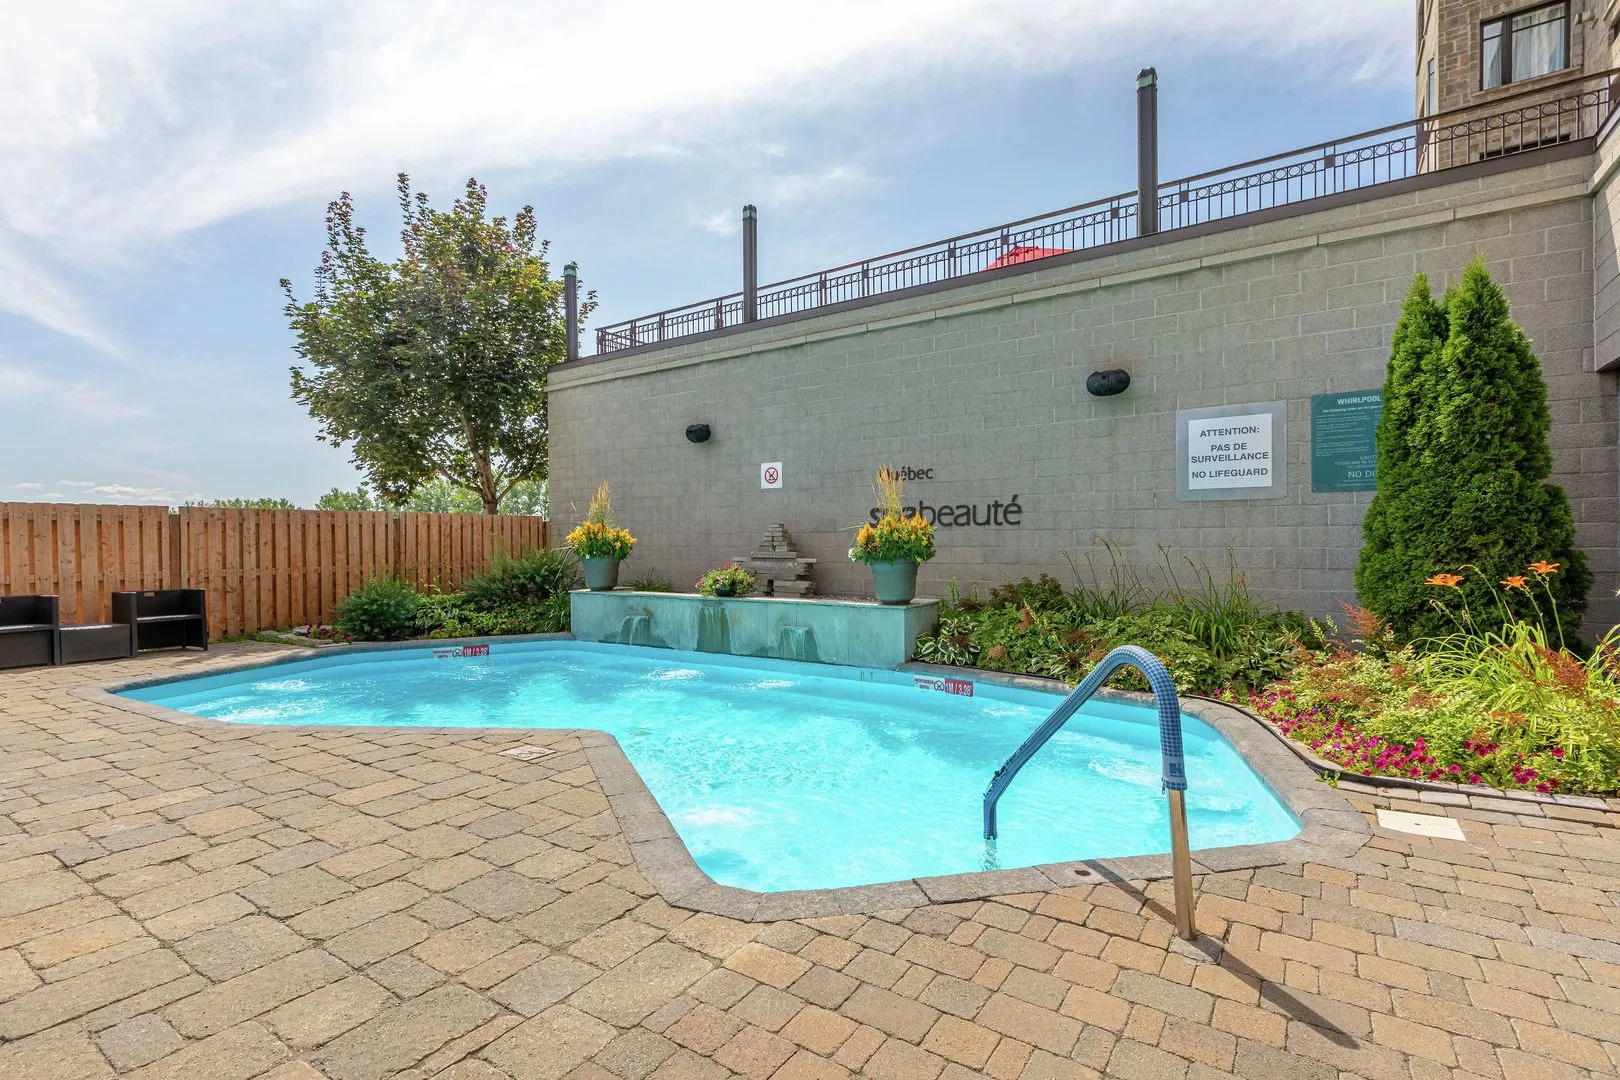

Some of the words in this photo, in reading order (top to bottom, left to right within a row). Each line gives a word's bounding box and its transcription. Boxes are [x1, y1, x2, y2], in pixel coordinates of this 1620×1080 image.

[1337, 395, 1382, 405] WHIRLPOOL
[1200, 426, 1260, 437] ATTENTION:
[1211, 443, 1230, 452] PAS
[1233, 443, 1248, 451] DE
[1191, 452, 1269, 463] SURVEILLANCE
[1192, 471, 1206, 479] NO
[1209, 468, 1268, 478] LIFEGUARD
[1348, 470, 1362, 478] NO
[1365, 470, 1377, 478] DI
